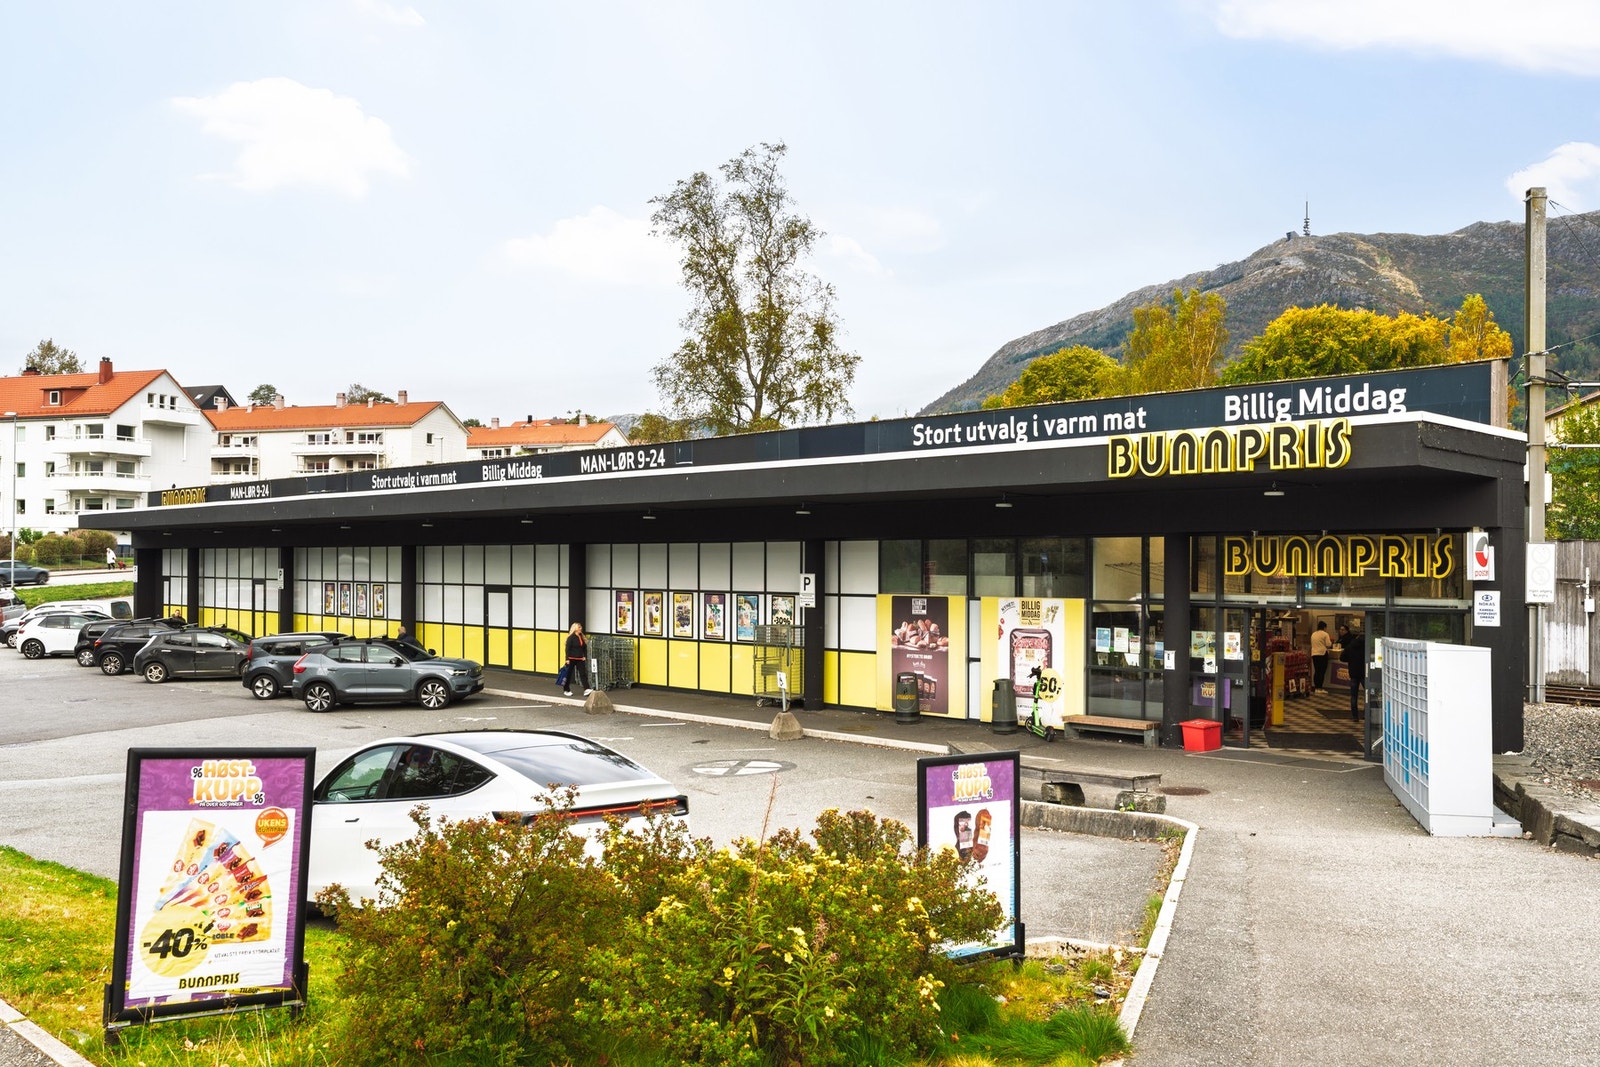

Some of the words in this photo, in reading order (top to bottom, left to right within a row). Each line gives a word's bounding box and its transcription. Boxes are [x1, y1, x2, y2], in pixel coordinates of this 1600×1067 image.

[1224, 392, 1292, 422] Billig
[1299, 382, 1407, 414] Middag
[912, 422, 962, 446] Stort
[966, 415, 1028, 444] utvalg
[1032, 414, 1039, 437] i
[1043, 413, 1098, 436] varm
[1103, 407, 1147, 431] mat
[1107, 417, 1352, 479] BUNNPRIS
[580, 451, 635, 473] MAN-LØR
[637, 447, 666, 469] 9-24
[371, 474, 392, 489] Stort
[391, 472, 416, 489] utvalg
[416, 472, 420, 486] i
[420, 474, 440, 486] varm
[440, 470, 457, 484] mat
[482, 464, 506, 481] Billig
[507, 461, 543, 479] Middag
[230, 485, 256, 499] MAN-LØR
[256, 484, 269, 498] 9-24
[1224, 534, 1454, 580] BUNNPRIS
[803, 576, 811, 591] P
[1021, 600, 1041, 610] BILLIG
[1021, 610, 1041, 618] MIDDAG
[203, 761, 255, 778] HØST-
[959, 765, 986, 779] HØST-
[195, 779, 261, 801] KUPP
[955, 778, 991, 798] KUPP
[257, 818, 286, 828] UKENS
[143, 927, 208, 959] -40%
[178, 972, 240, 990] BUNNPRIS
